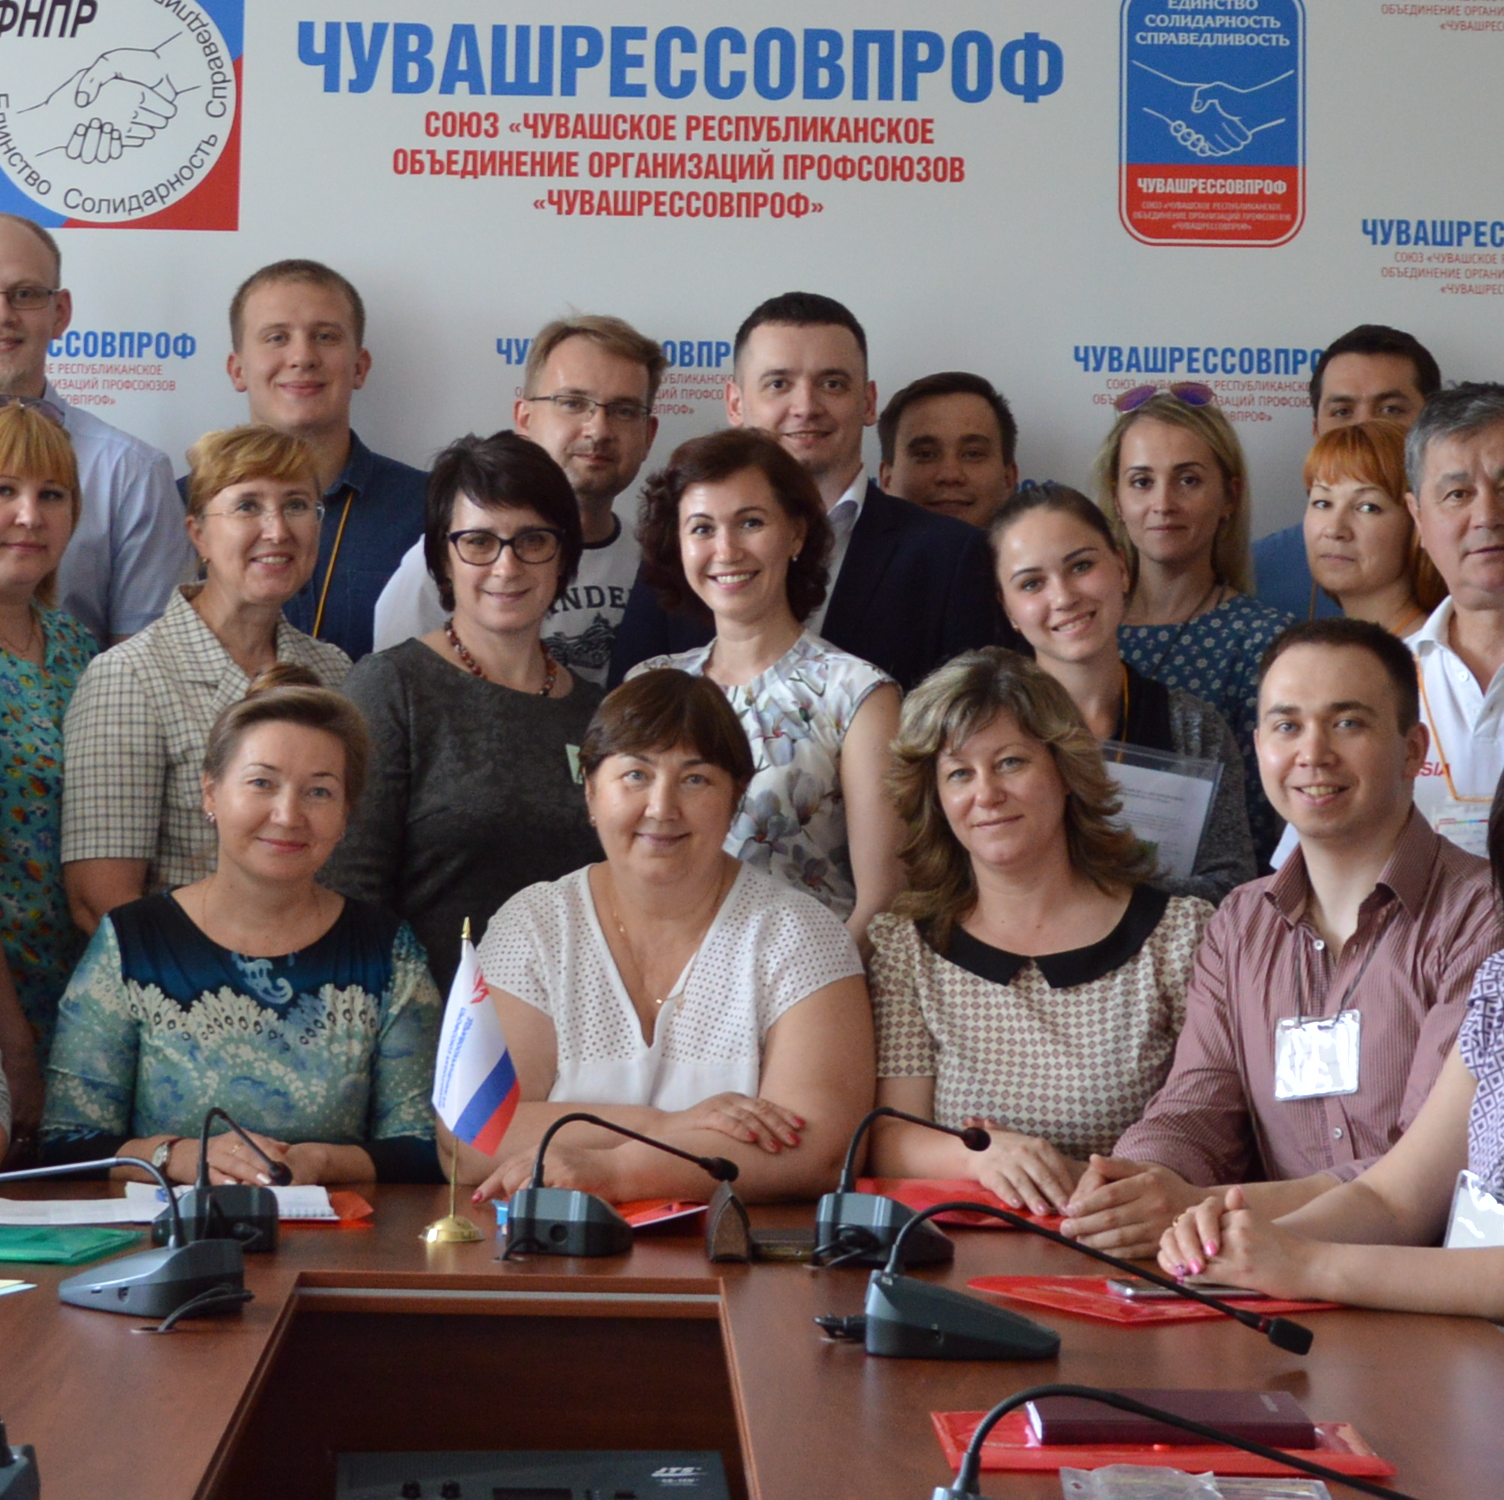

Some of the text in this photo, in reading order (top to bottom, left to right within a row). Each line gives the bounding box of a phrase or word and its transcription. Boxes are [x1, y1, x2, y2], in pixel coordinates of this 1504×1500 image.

[1382, 3, 1461, 17] ОБЪЕДИНЕНИЕ
[1145, 14, 1281, 29] СОЛИДАРНОСТЬ
[1135, 32, 1290, 47] СПРАВЕДЛИВОСТЬ
[298, 21, 1064, 103] ЧУВАШРЕССОВПРОФ
[425, 111, 934, 145] СОЮЗ «ЧУВАШСКОЕ РЕСПУБЛИКАНСКОЕ
[393, 148, 965, 183] ОБЪЕДИНЕНИЕ ОРГАНИЗАЦИЙ ПРОФСОЮЗОВ
[63, 133, 218, 215] Солидарность
[1137, 177, 1287, 195] ЧУВАШРЕССОВПРОФ
[534, 189, 823, 219] «ЧУВАШРЕССОВПРОФ»
[1395, 252, 1426, 264] СОЮЗ
[1427, 253, 1499, 265] «ЧУВАШСКОЕ
[1381, 266, 1461, 280] ОБЪЕДИНЕНИЕ
[1074, 346, 1326, 375] ЧУВАШРЕССОВПРО
[58, 364, 163, 376] РЕСПУБЛИКАНСКОЕ
[101, 379, 176, 391] ПРОФСОЮЗОВ
